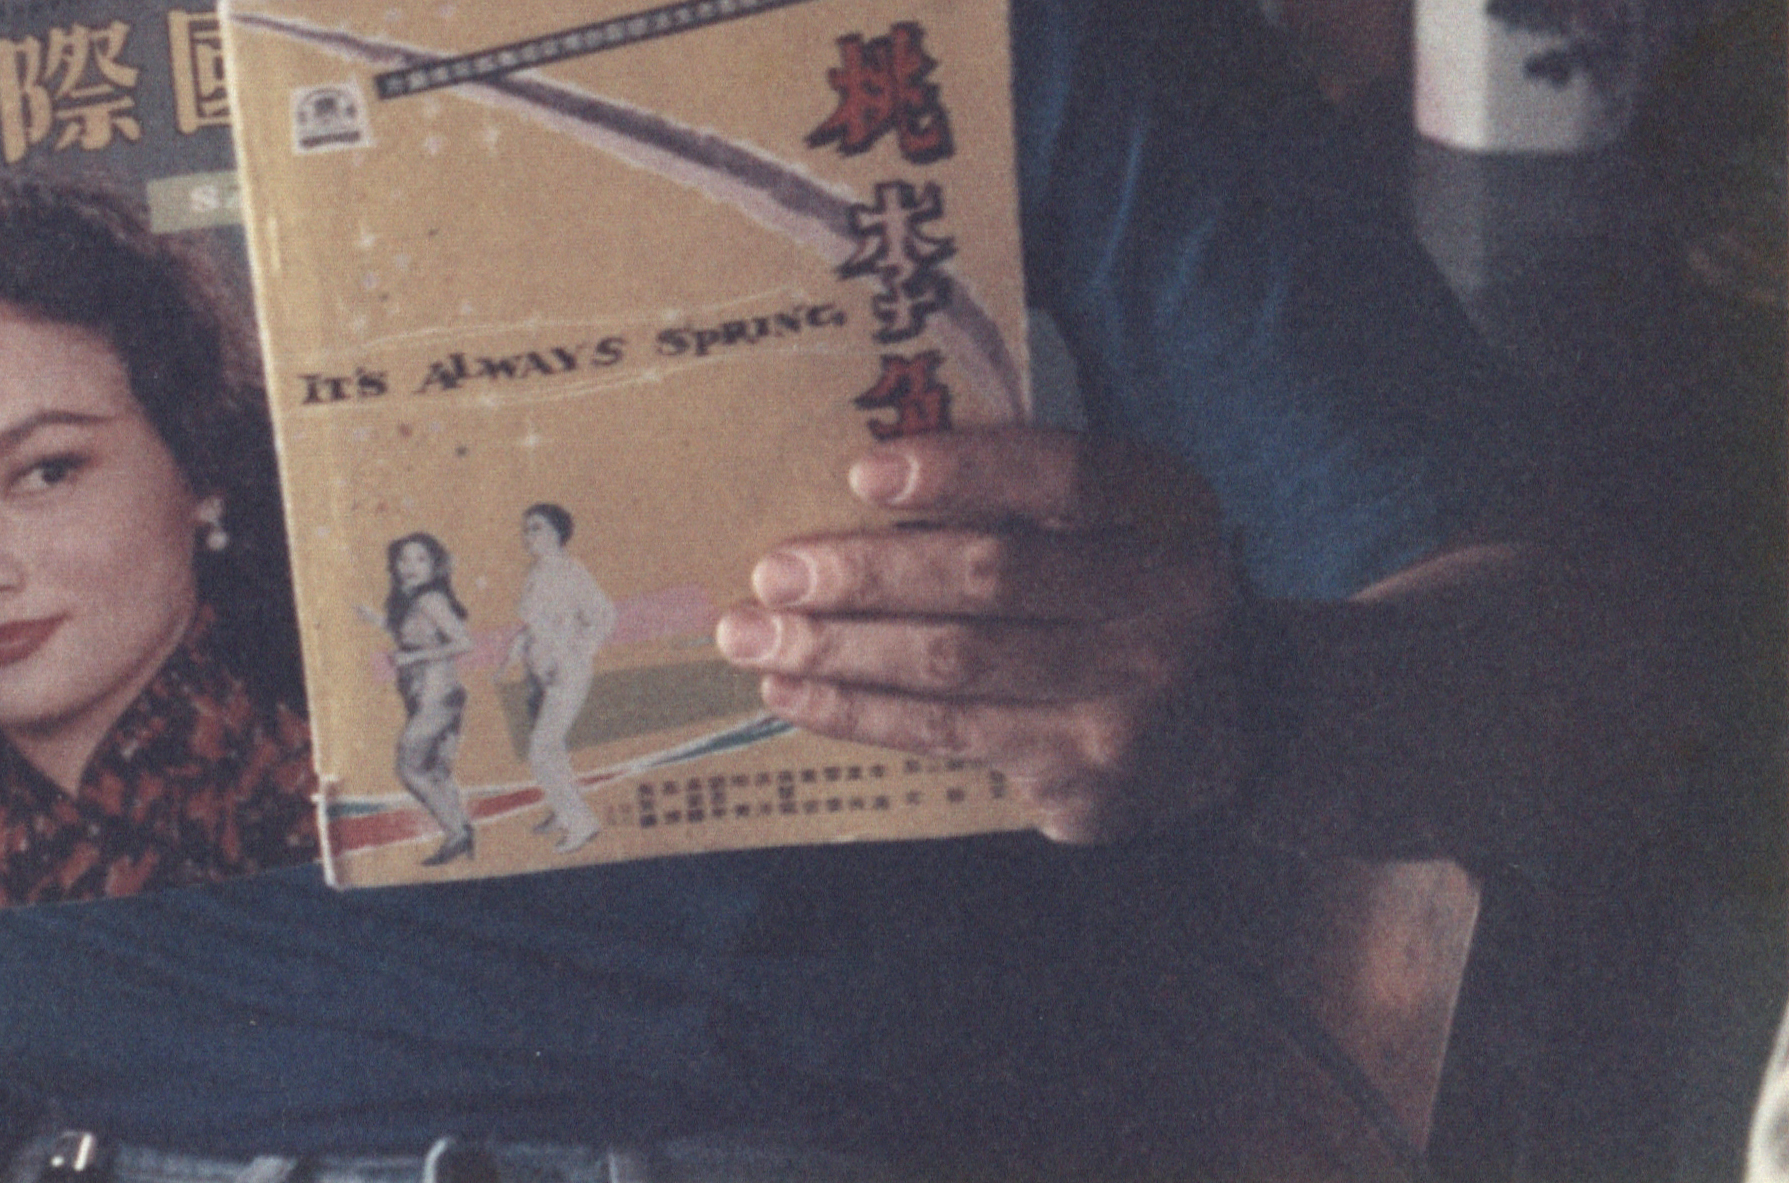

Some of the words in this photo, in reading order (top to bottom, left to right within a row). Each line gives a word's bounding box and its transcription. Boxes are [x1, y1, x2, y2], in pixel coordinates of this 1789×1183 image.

[298, 367, 388, 405] IT'S
[412, 337, 626, 394] ALWAYS
[656, 303, 847, 356] SPRING
